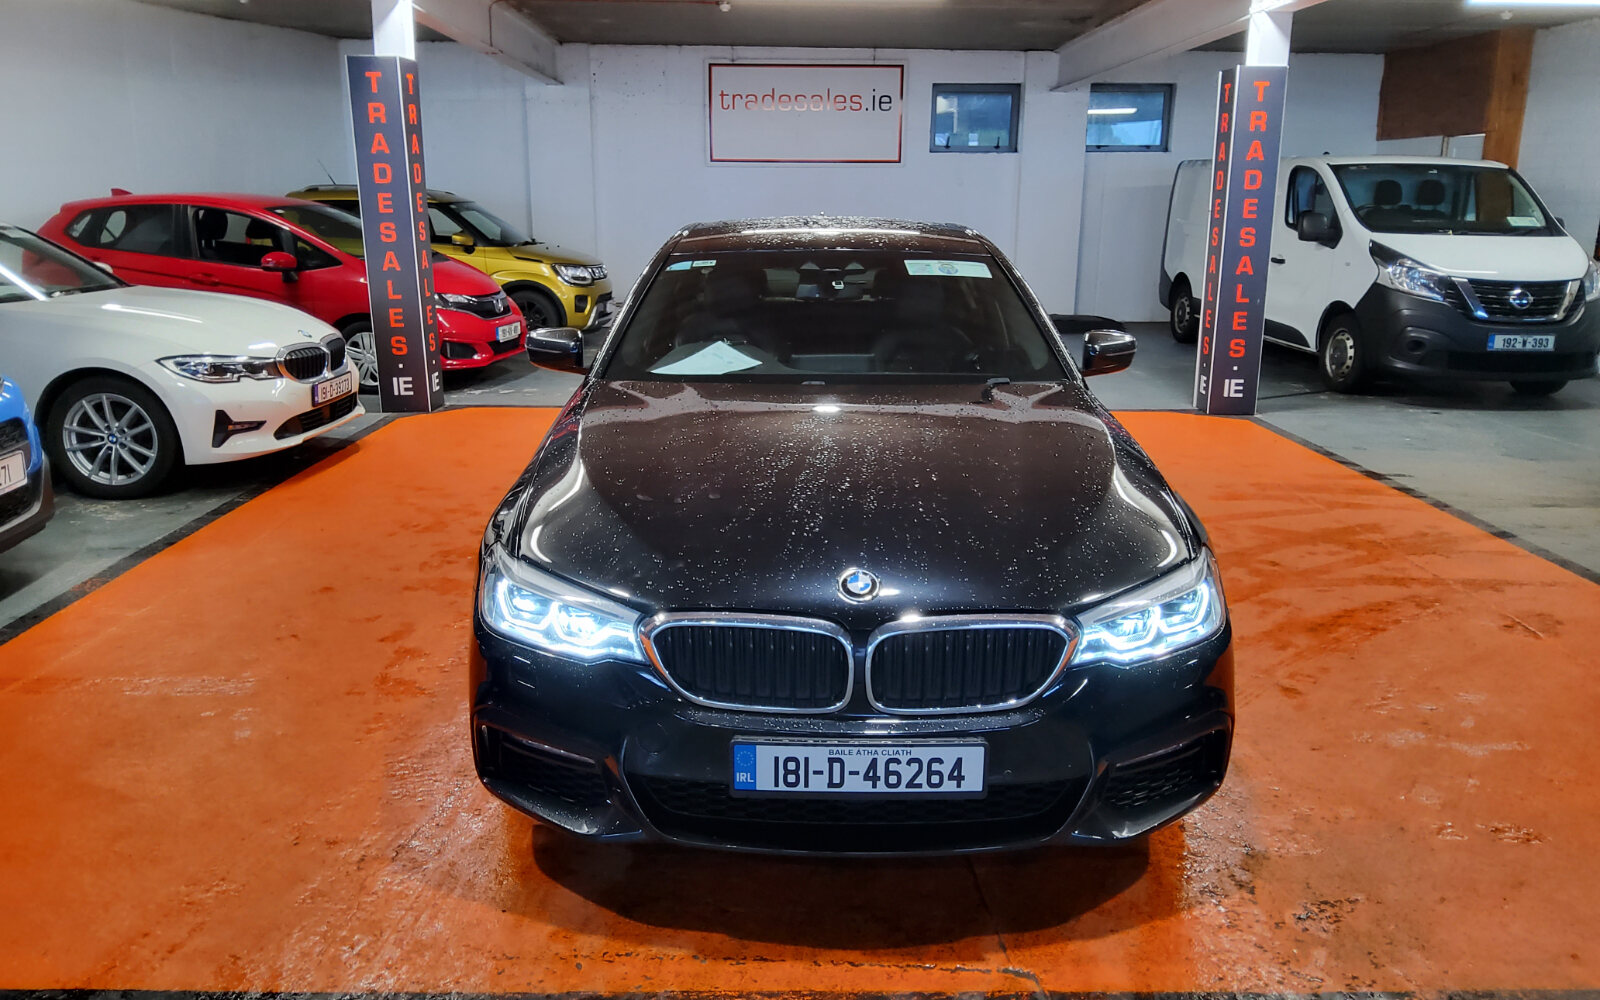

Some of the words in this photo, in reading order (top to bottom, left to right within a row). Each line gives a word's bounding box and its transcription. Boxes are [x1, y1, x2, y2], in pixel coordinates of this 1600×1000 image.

[719, 88, 892, 112] tradesales.ie
[1502, 337, 1550, 348] 192-W-393
[0, 464, 11, 486] 71
[736, 772, 755, 783] IRL
[773, 756, 965, 789] 181-D-46264
